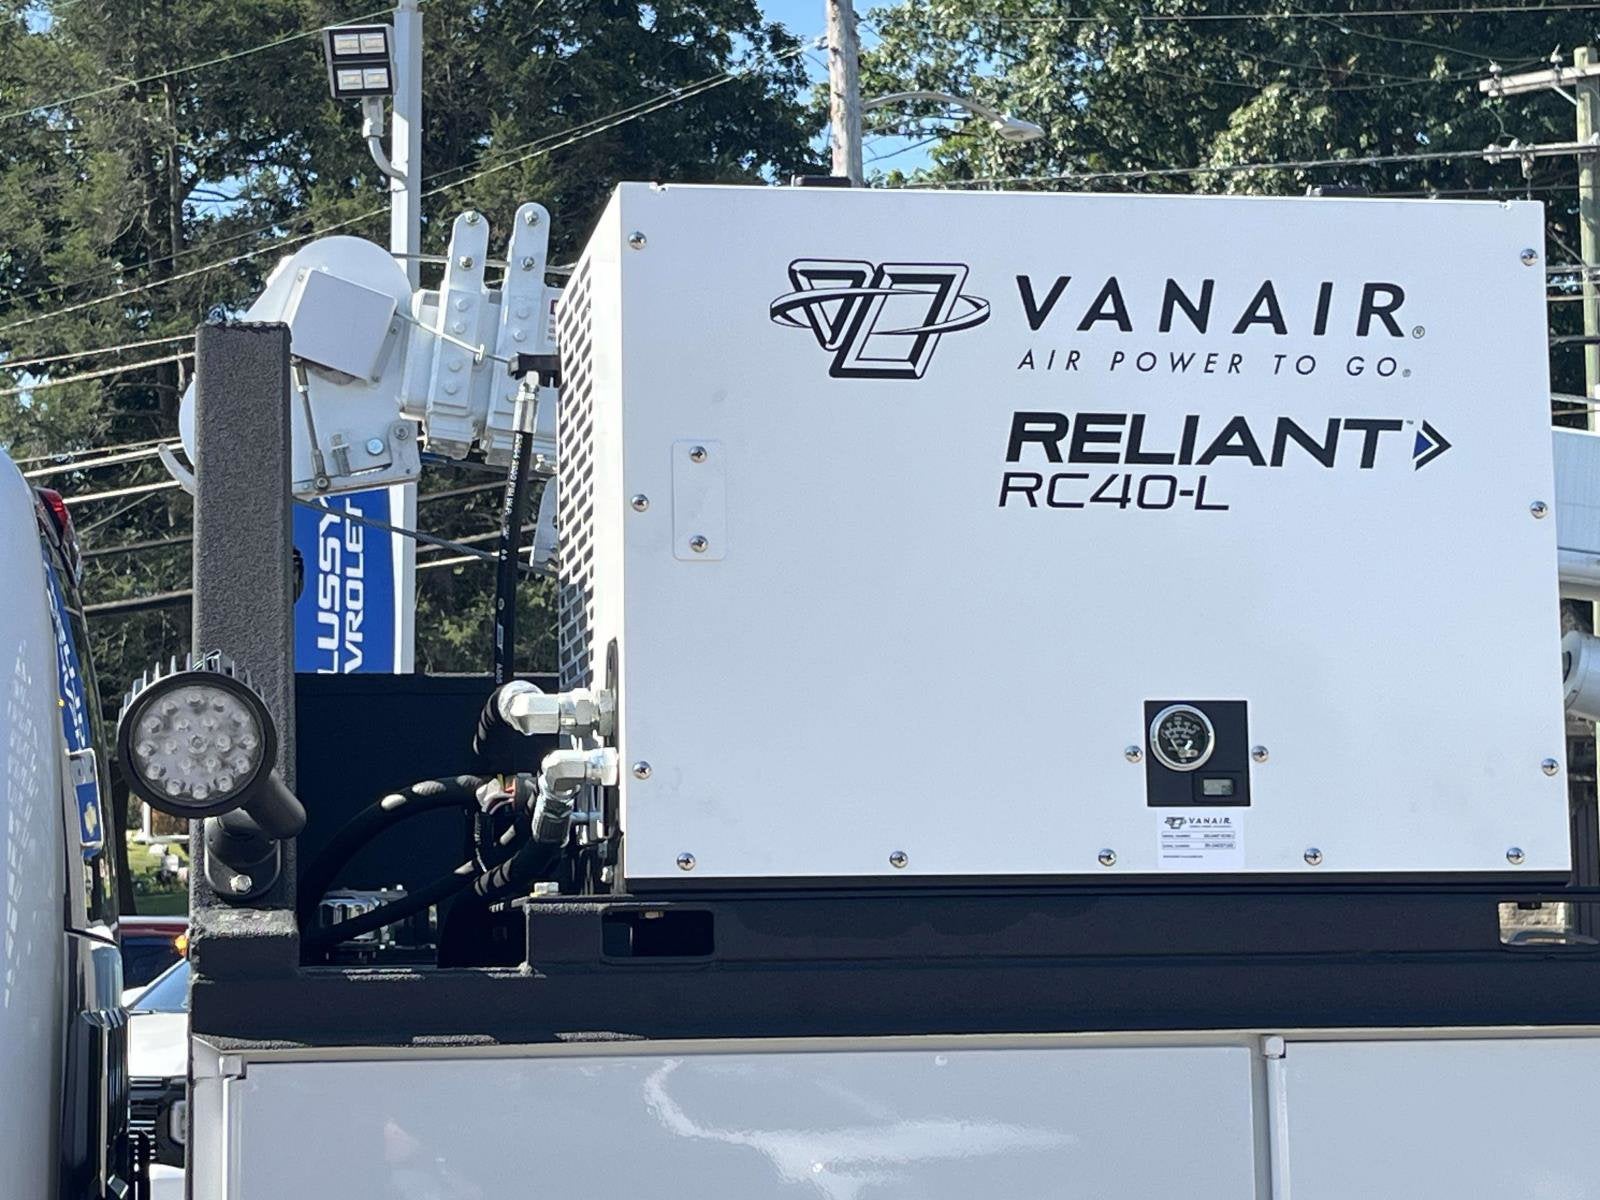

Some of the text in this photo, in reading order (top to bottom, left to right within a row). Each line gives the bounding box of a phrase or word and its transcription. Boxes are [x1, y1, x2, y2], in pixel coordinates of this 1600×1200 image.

[1017, 348, 1081, 371] AIR
[1109, 350, 1243, 375] POWER
[1274, 354, 1317, 376] TO
[1005, 411, 1404, 469] RELIANT
[998, 471, 1230, 511] RC40-L
[1189, 817, 1231, 825] VANAIR
